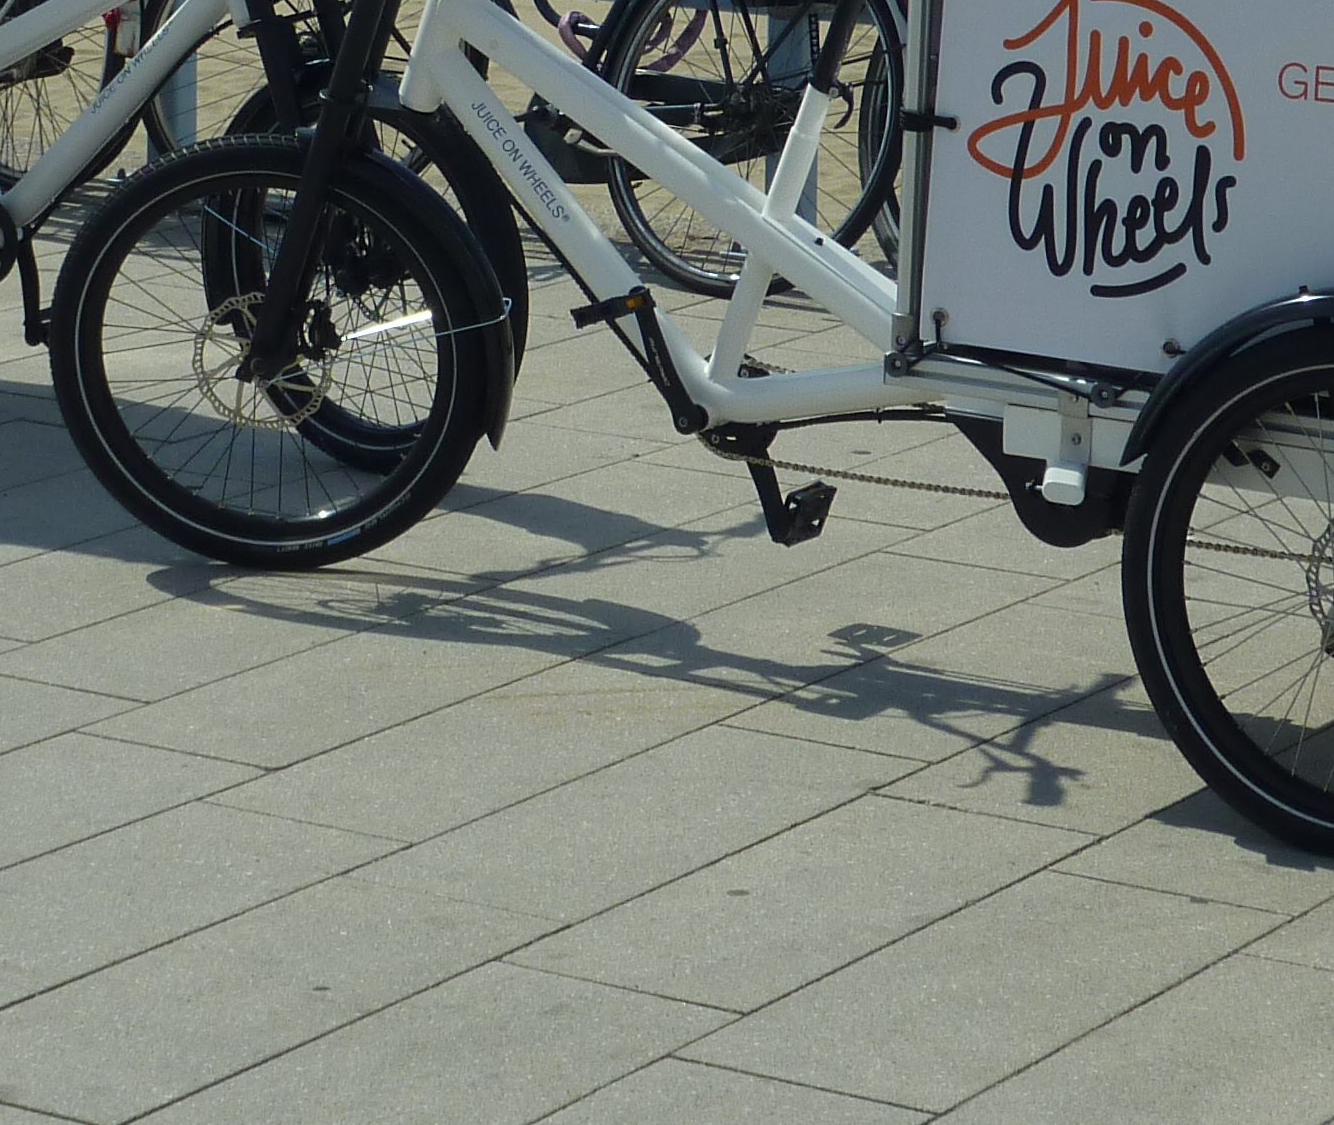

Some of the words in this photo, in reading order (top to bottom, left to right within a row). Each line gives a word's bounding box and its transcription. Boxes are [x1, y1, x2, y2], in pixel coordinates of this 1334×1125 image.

[471, 102, 507, 141] JUICE
[502, 139, 524, 162] ON
[1099, 121, 1171, 174] on
[991, 60, 1237, 277] Wheels
